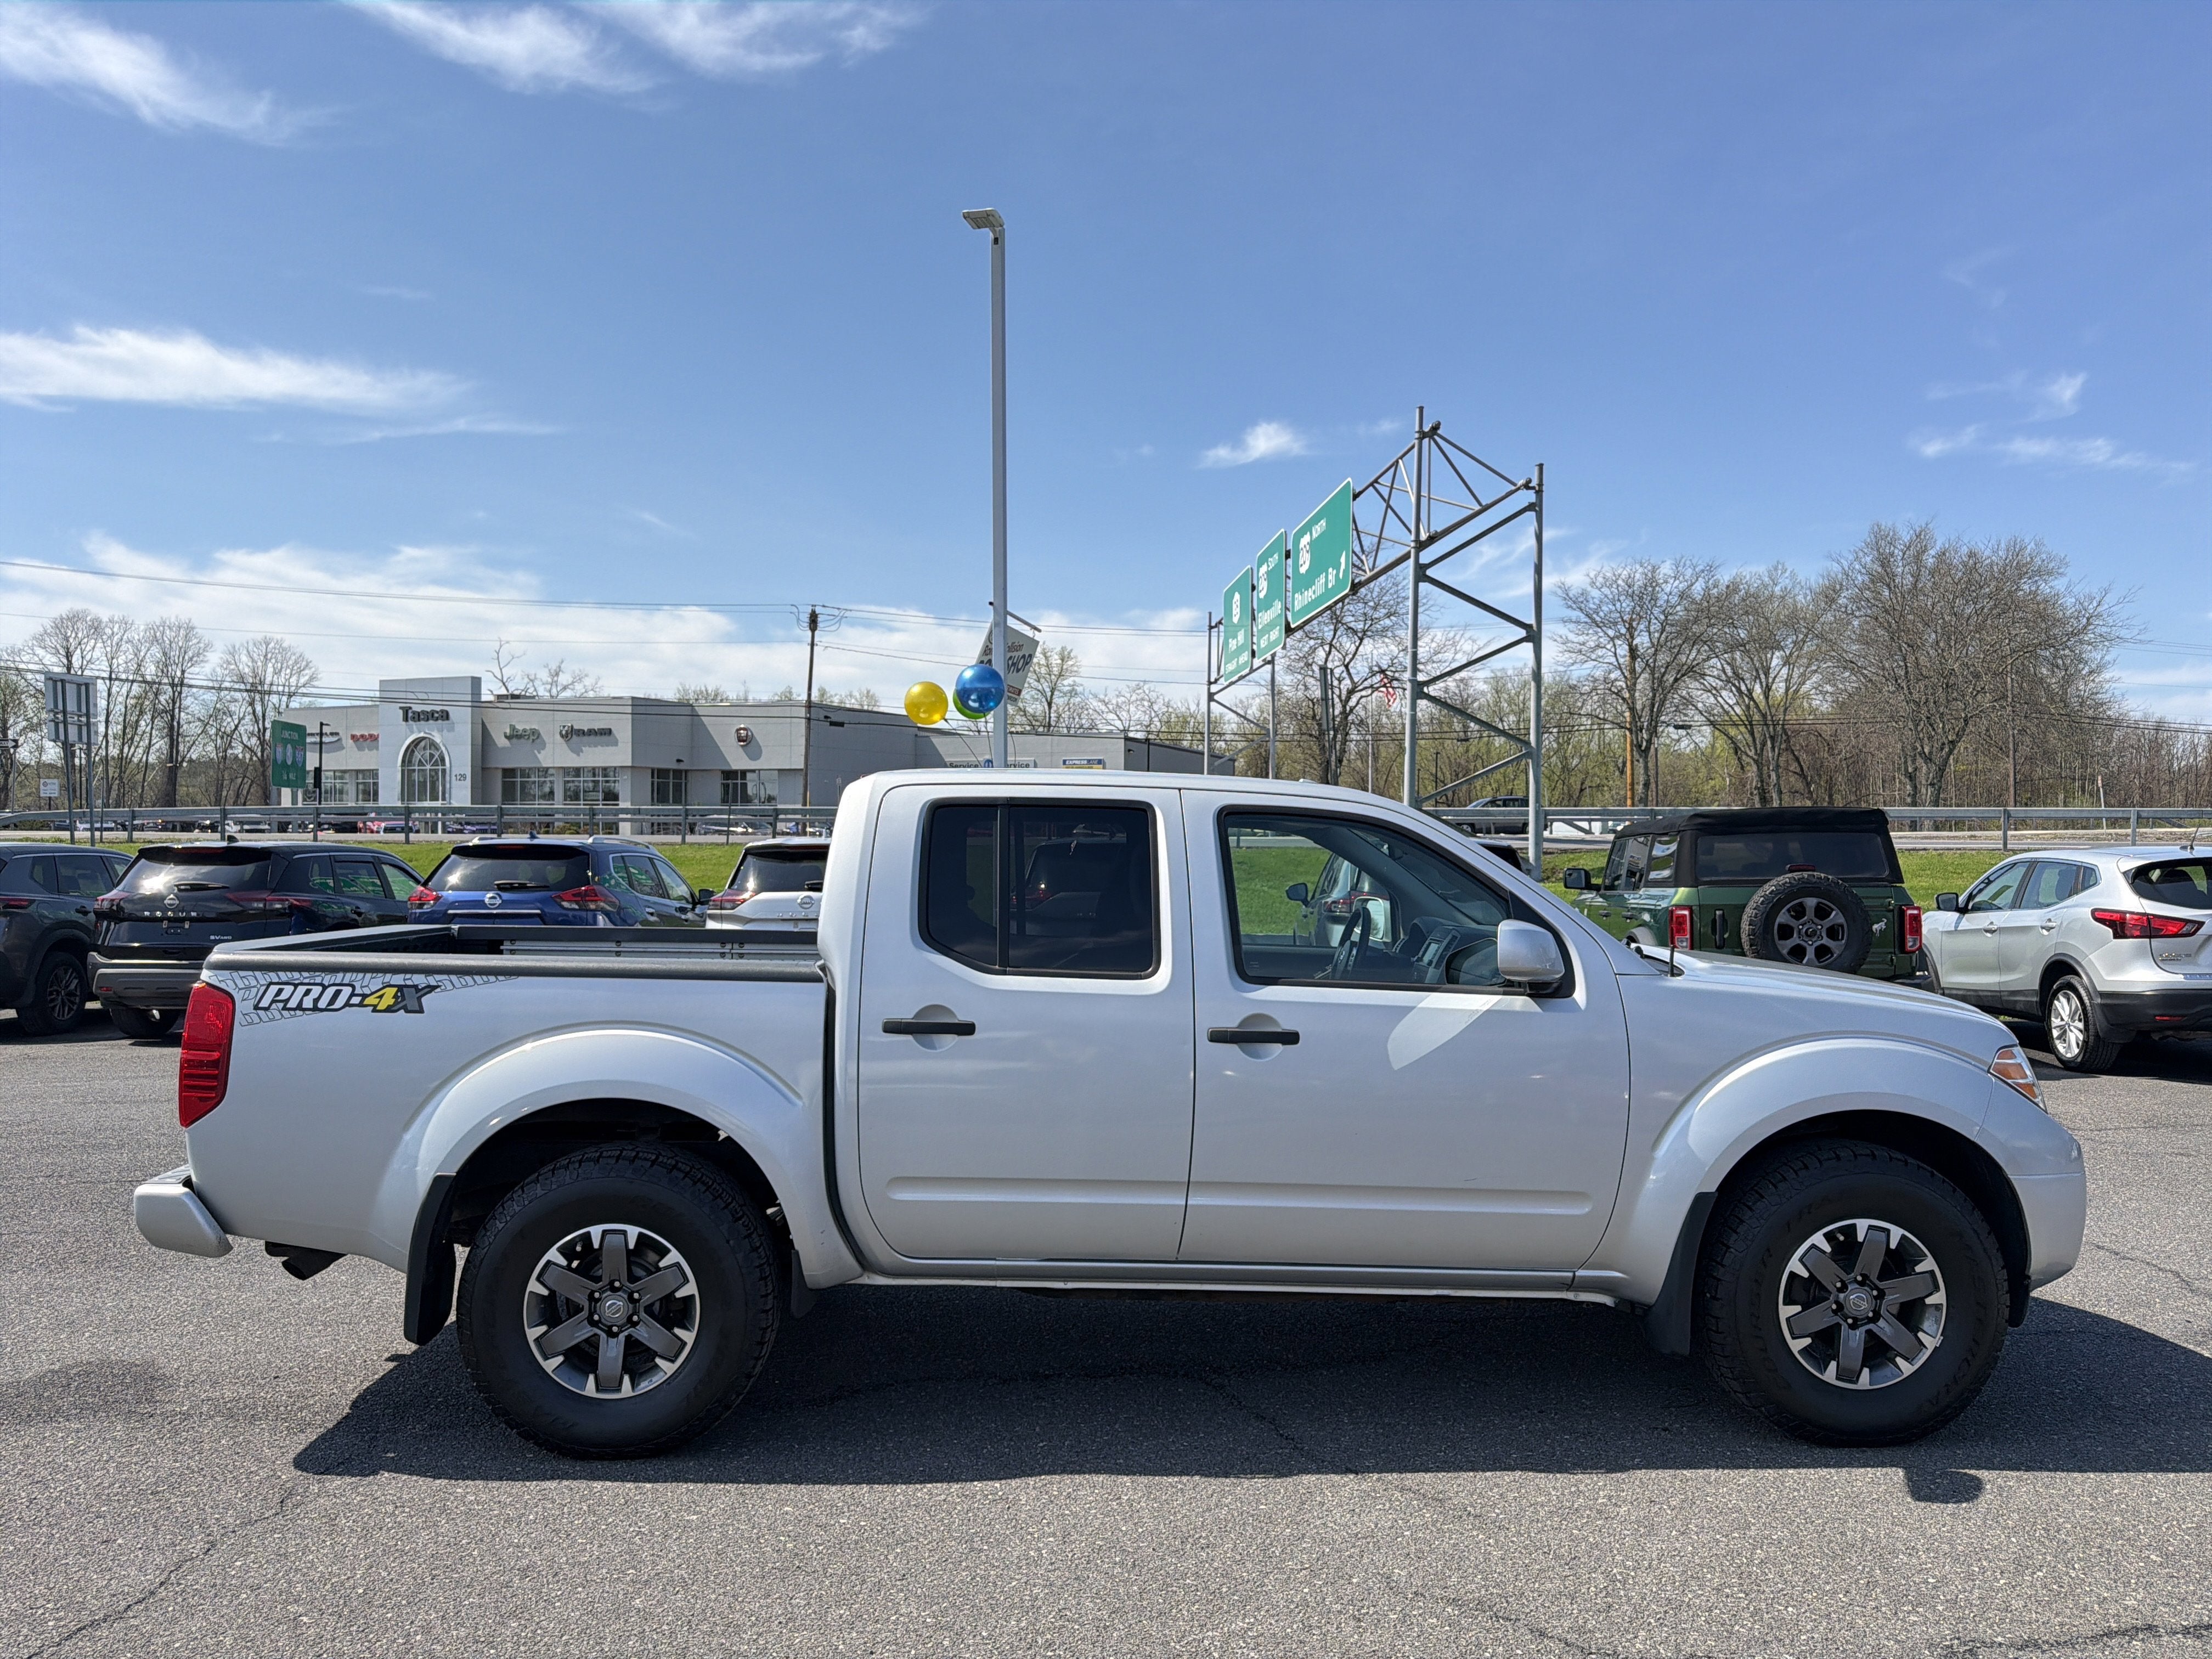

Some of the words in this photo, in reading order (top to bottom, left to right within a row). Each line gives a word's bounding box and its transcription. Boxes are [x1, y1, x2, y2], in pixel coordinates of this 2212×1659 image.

[1312, 517, 1327, 541] NORTH
[1300, 541, 1310, 568] 209
[1295, 572, 1326, 613] Rhinecliff
[1328, 567, 1336, 589] Br
[1007, 641, 1024, 653] ollision
[399, 706, 450, 723] Tasca
[350, 733, 380, 742] DOD
[504, 724, 540, 743] Jeep
[574, 728, 612, 737] RAM
[255, 982, 442, 1013] PRO-4X
